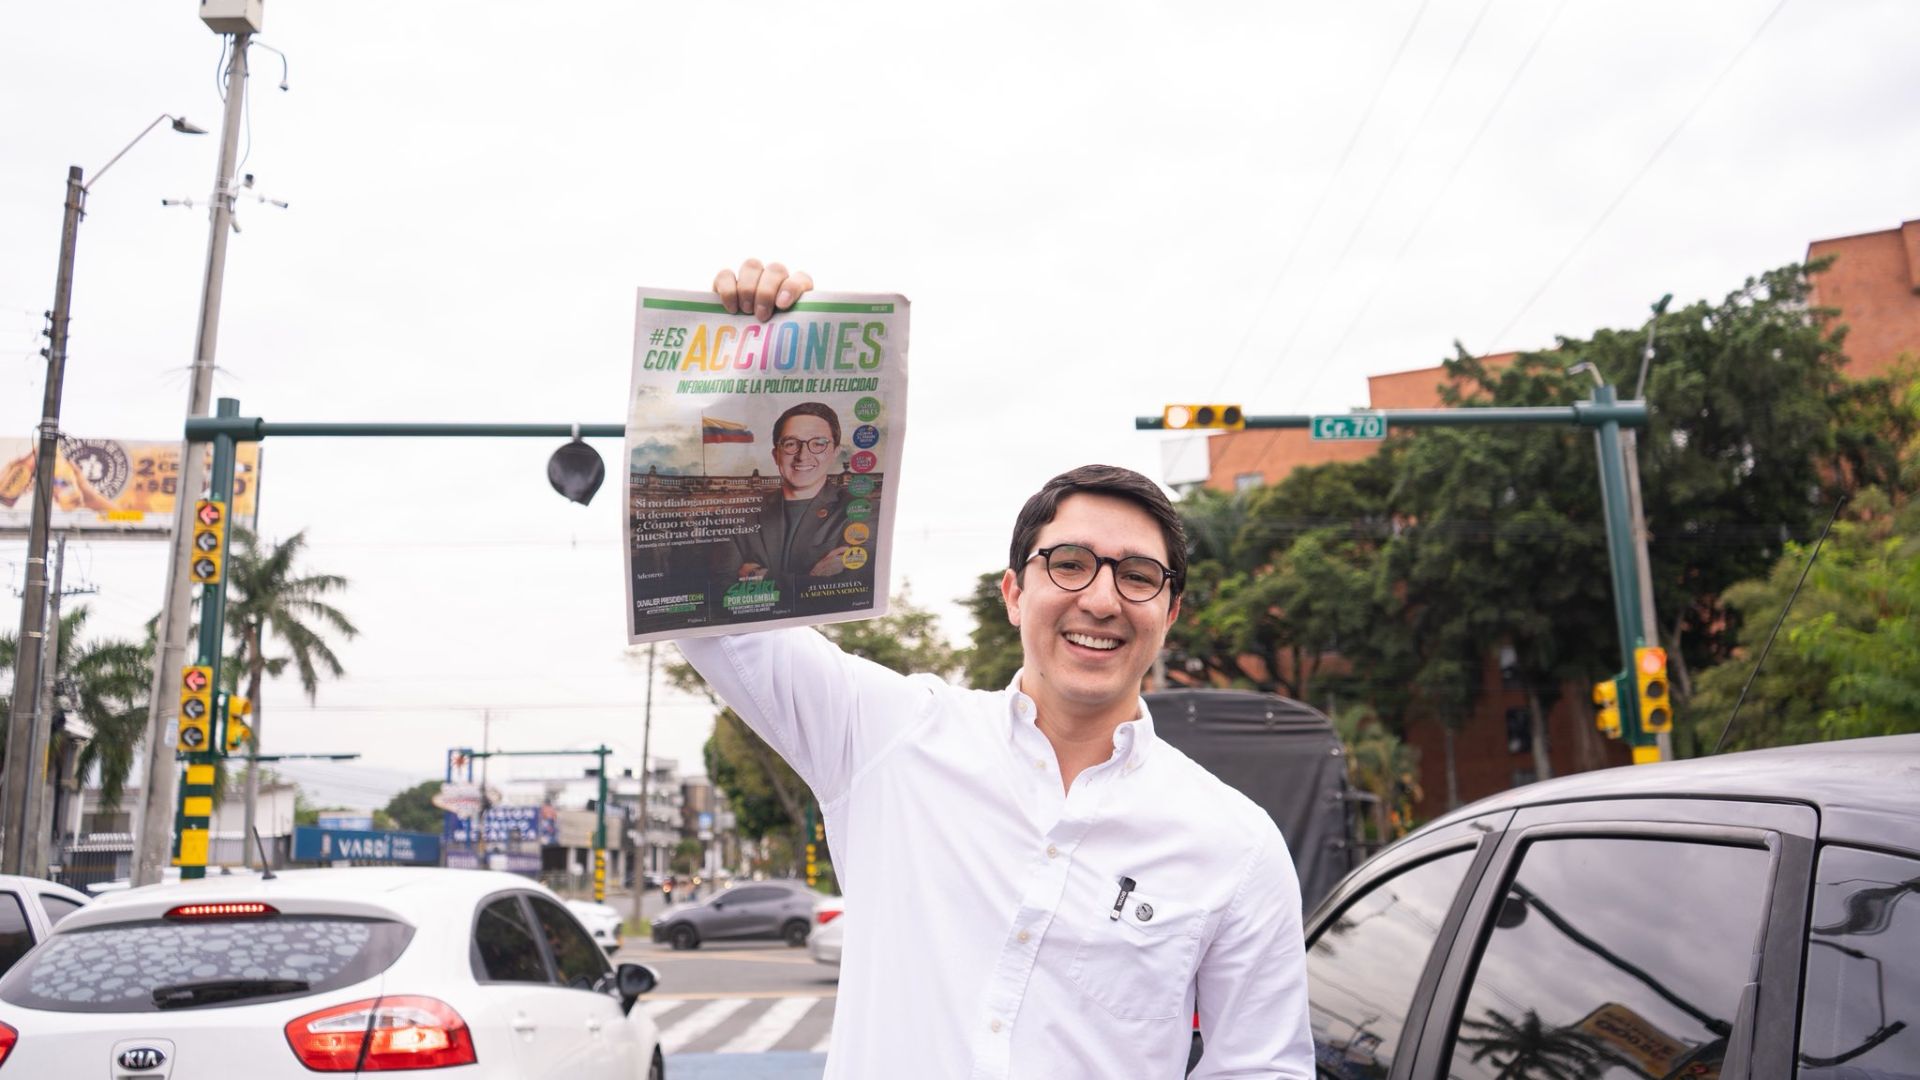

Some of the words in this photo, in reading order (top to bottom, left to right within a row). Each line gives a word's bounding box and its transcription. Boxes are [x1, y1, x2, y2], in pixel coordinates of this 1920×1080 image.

[649, 327, 688, 348] #ES
[681, 322, 885, 372] ACCIONES
[643, 349, 682, 371] CON
[676, 379, 734, 394] INFORMATIVO
[735, 379, 749, 394] DE
[750, 379, 762, 394] LA
[763, 375, 804, 394] POLÍTICA
[805, 379, 819, 393] DE
[820, 379, 832, 392] LA
[832, 377, 880, 392] FELICIDAD
[1320, 418, 1350, 438] Cr.
[1352, 417, 1381, 438] 70
[137, 458, 156, 476] 2
[635, 498, 646, 508] Si
[648, 500, 662, 508] no
[728, 495, 764, 505] muere
[636, 510, 646, 520] la
[714, 506, 762, 516] entonces
[636, 519, 679, 533] ¿Cómo
[679, 516, 746, 529] resolvemos
[636, 530, 689, 542] nuestras
[690, 524, 761, 539] diferencias?
[727, 594, 744, 606] POR
[744, 591, 775, 604] COLOMBIA
[124, 1050, 158, 1067] KIA
